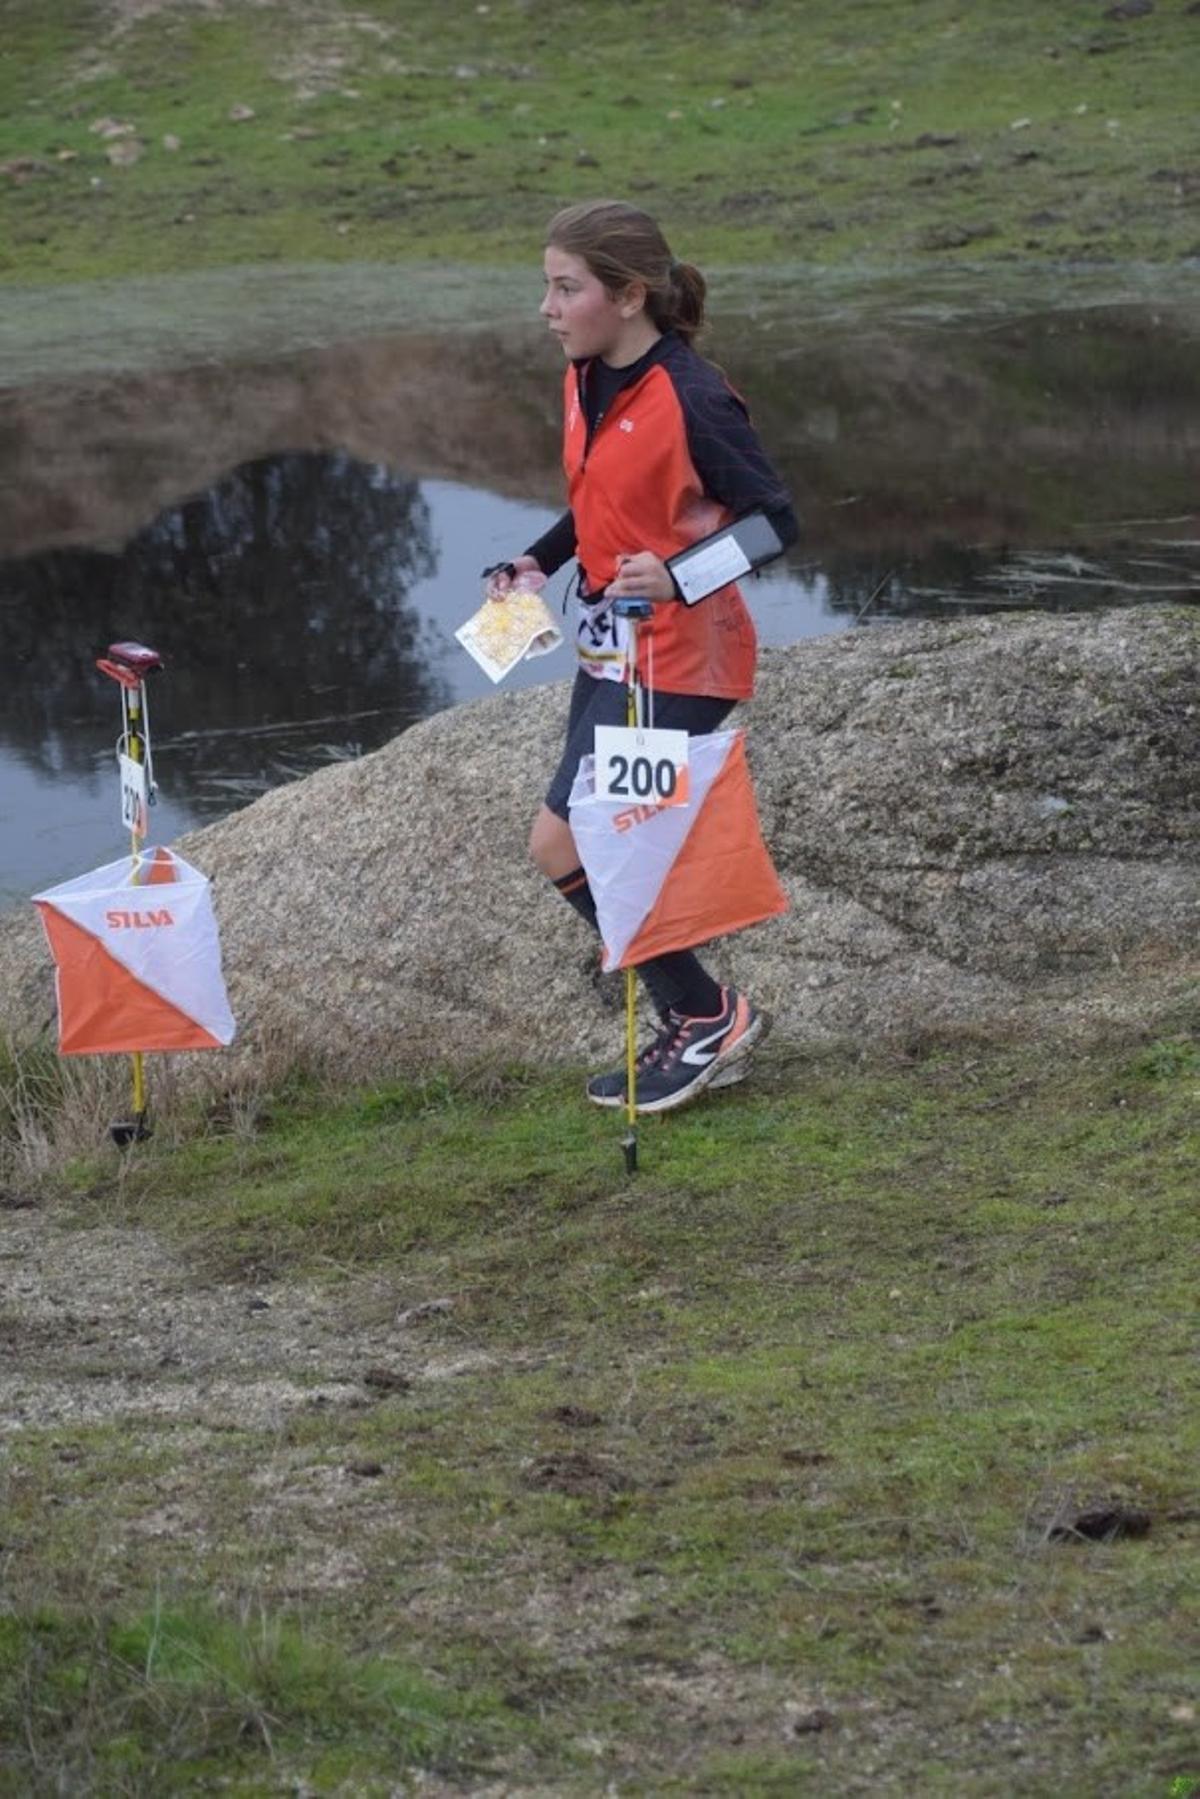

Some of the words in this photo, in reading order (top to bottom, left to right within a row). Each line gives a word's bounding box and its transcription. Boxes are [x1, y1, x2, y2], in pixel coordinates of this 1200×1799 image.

[608, 754, 677, 798] 200
[612, 804, 666, 833] SIL
[106, 909, 174, 929] SILVA
